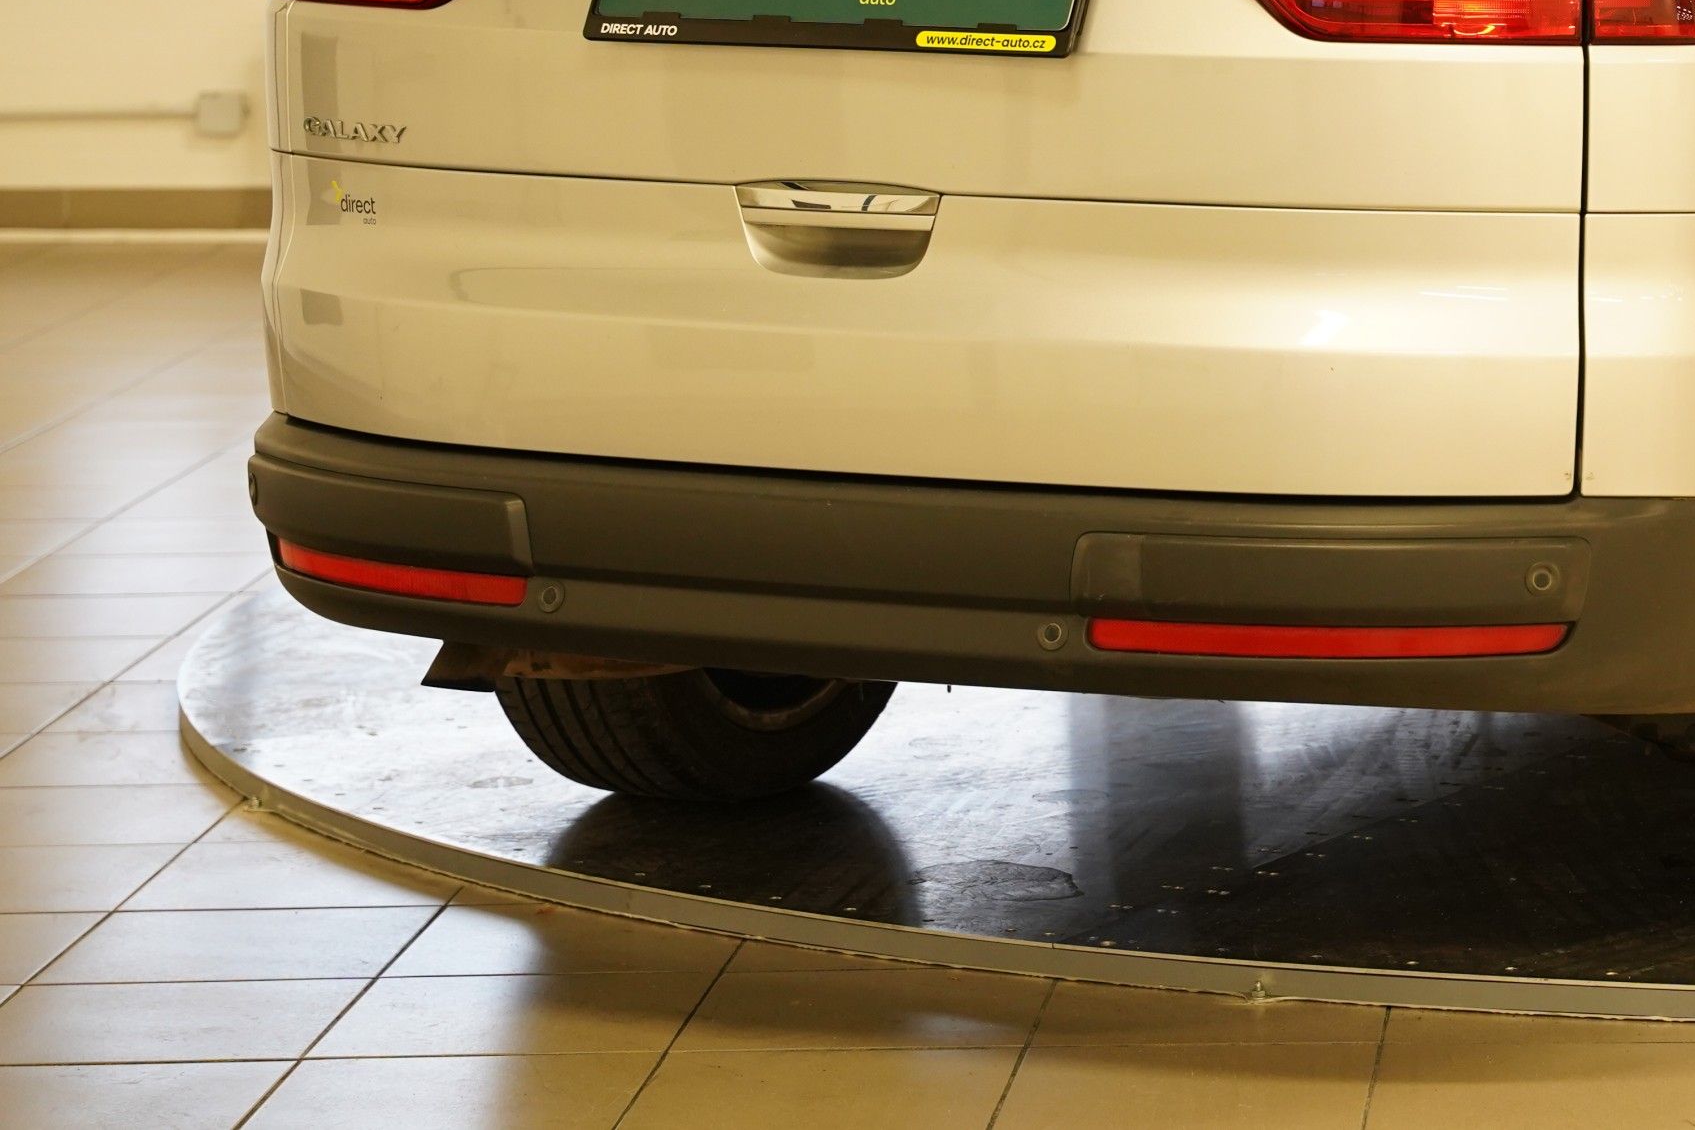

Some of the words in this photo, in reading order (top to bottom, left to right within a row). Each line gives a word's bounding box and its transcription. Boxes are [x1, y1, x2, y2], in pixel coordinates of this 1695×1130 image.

[600, 22, 644, 35] DIRECT
[643, 24, 678, 37] AUTO
[925, 34, 1047, 49] www.direct-auto.cz
[303, 116, 408, 144] GALAXY
[340, 194, 377, 215] direct
